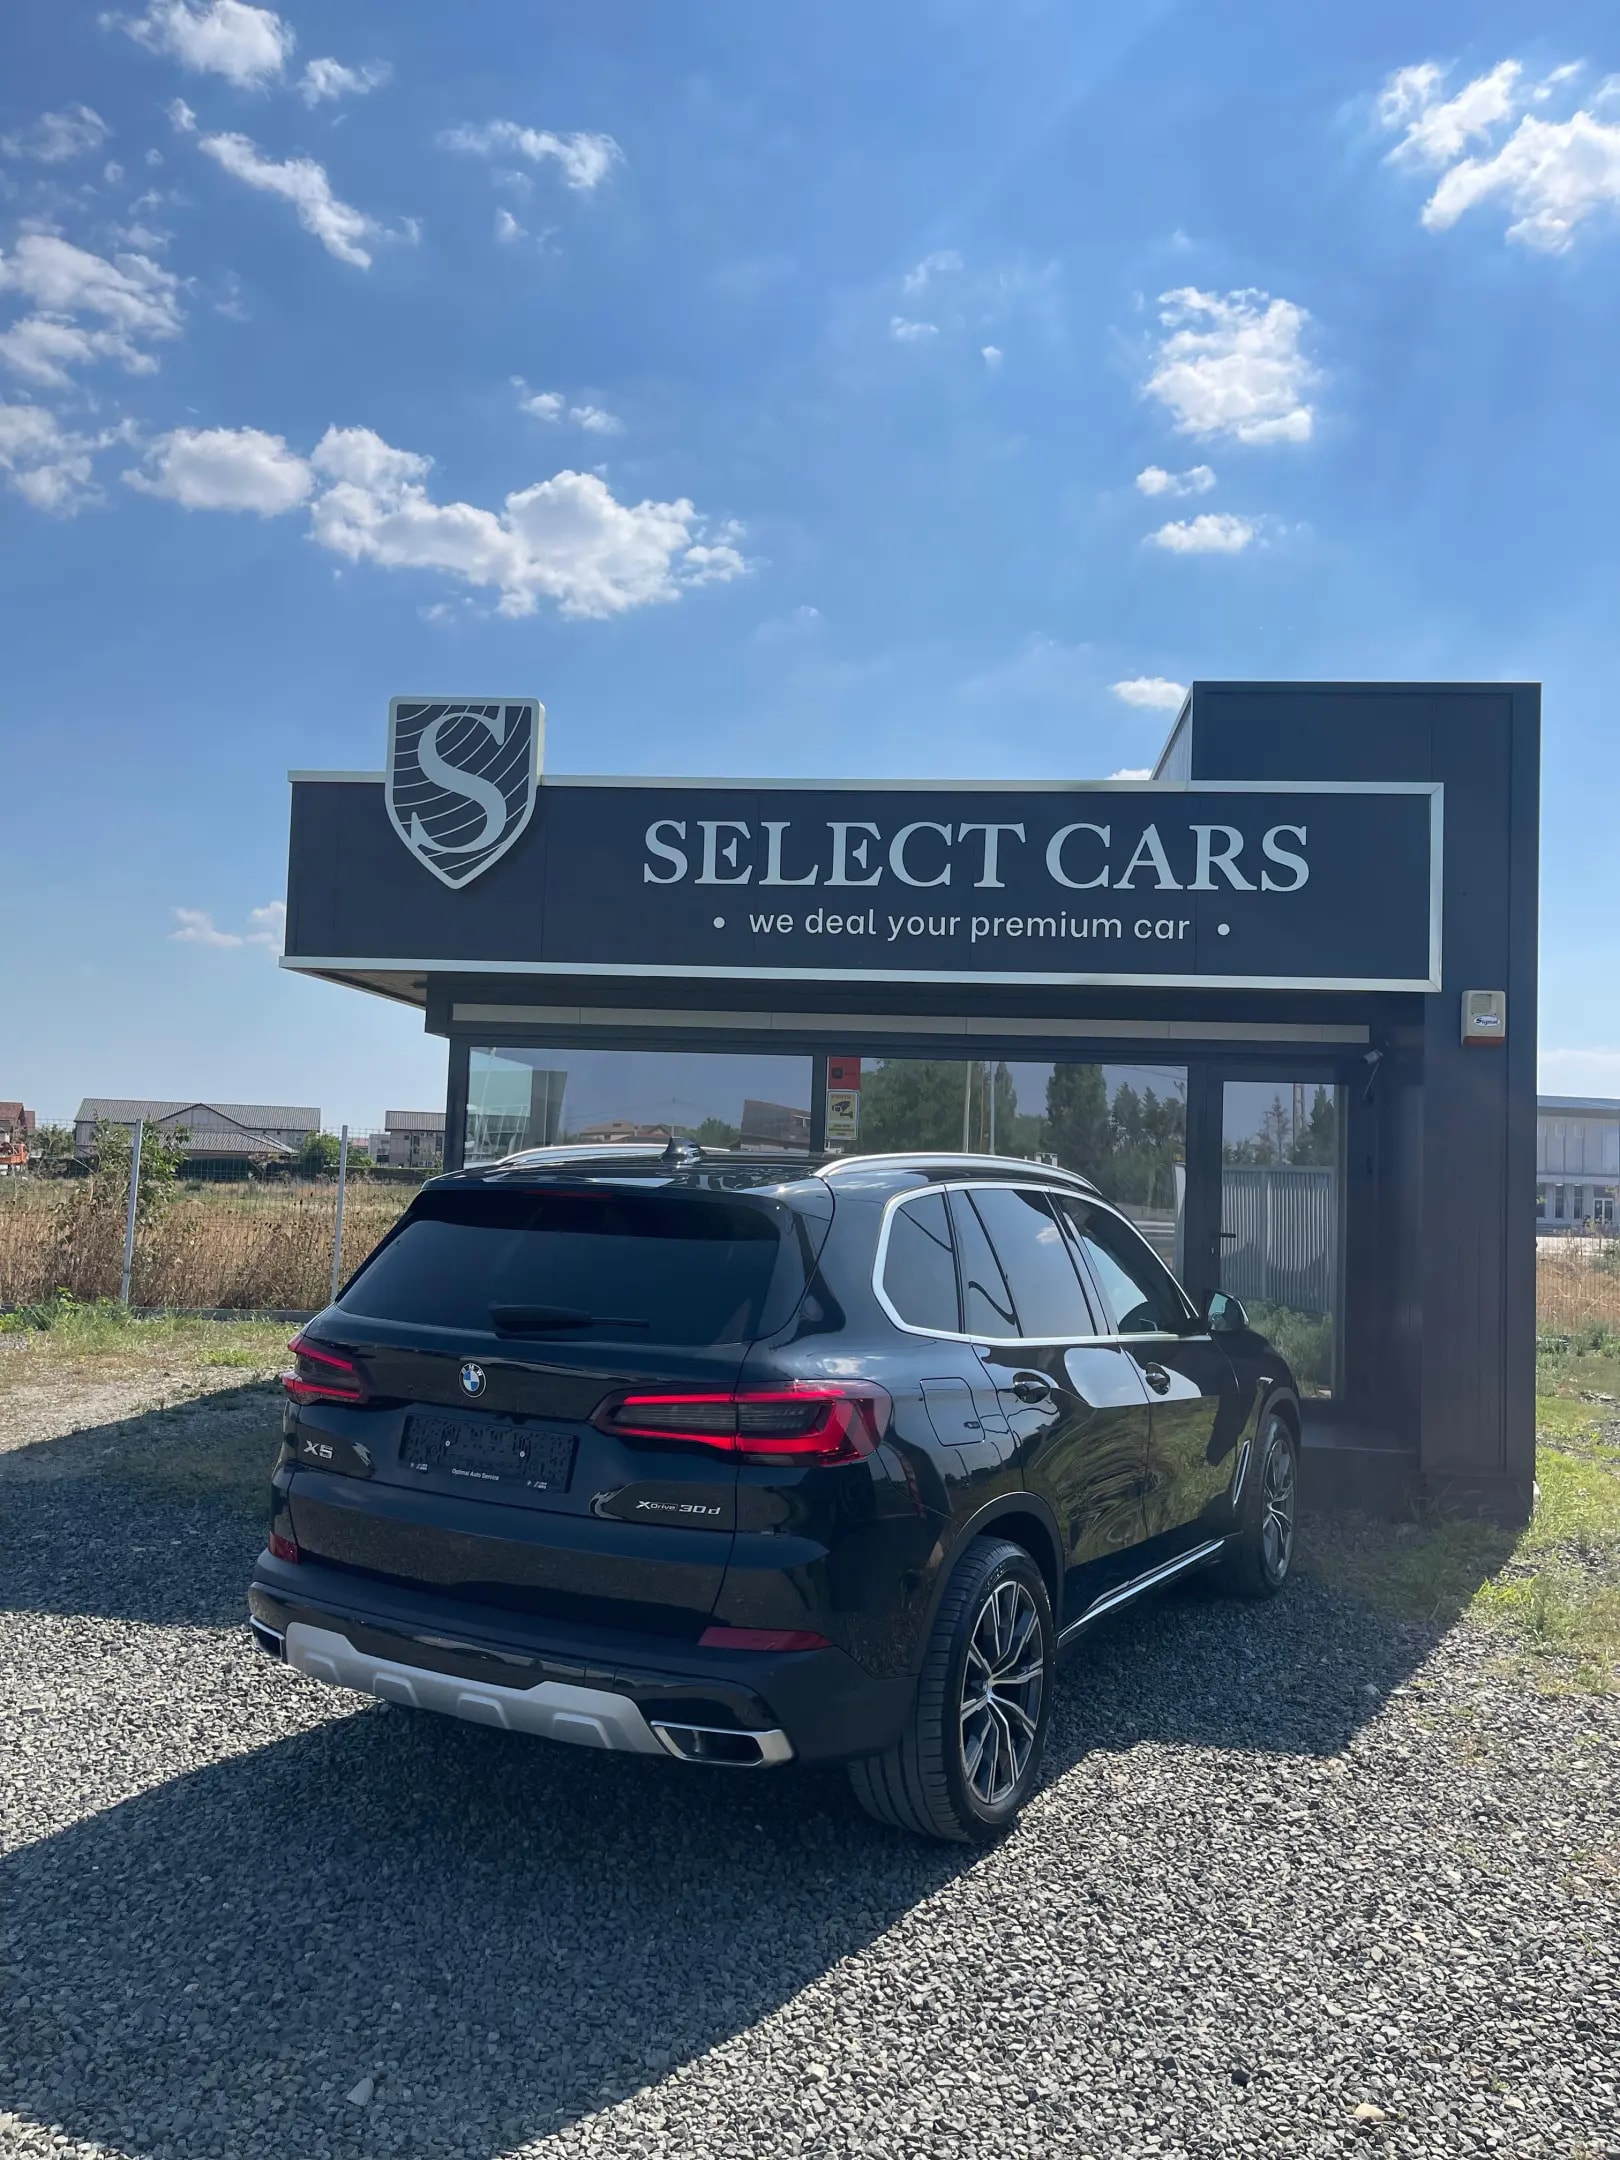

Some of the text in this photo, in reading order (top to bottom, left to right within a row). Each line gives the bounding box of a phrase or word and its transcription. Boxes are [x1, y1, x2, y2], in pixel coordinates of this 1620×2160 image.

[411, 706, 507, 853] S
[643, 819, 1310, 892] SELECT CARS
[749, 907, 1190, 943] we deal your premium car
[303, 1440, 334, 1459] X5
[451, 1468, 469, 1476] Optimal
[481, 1472, 499, 1480] Service
